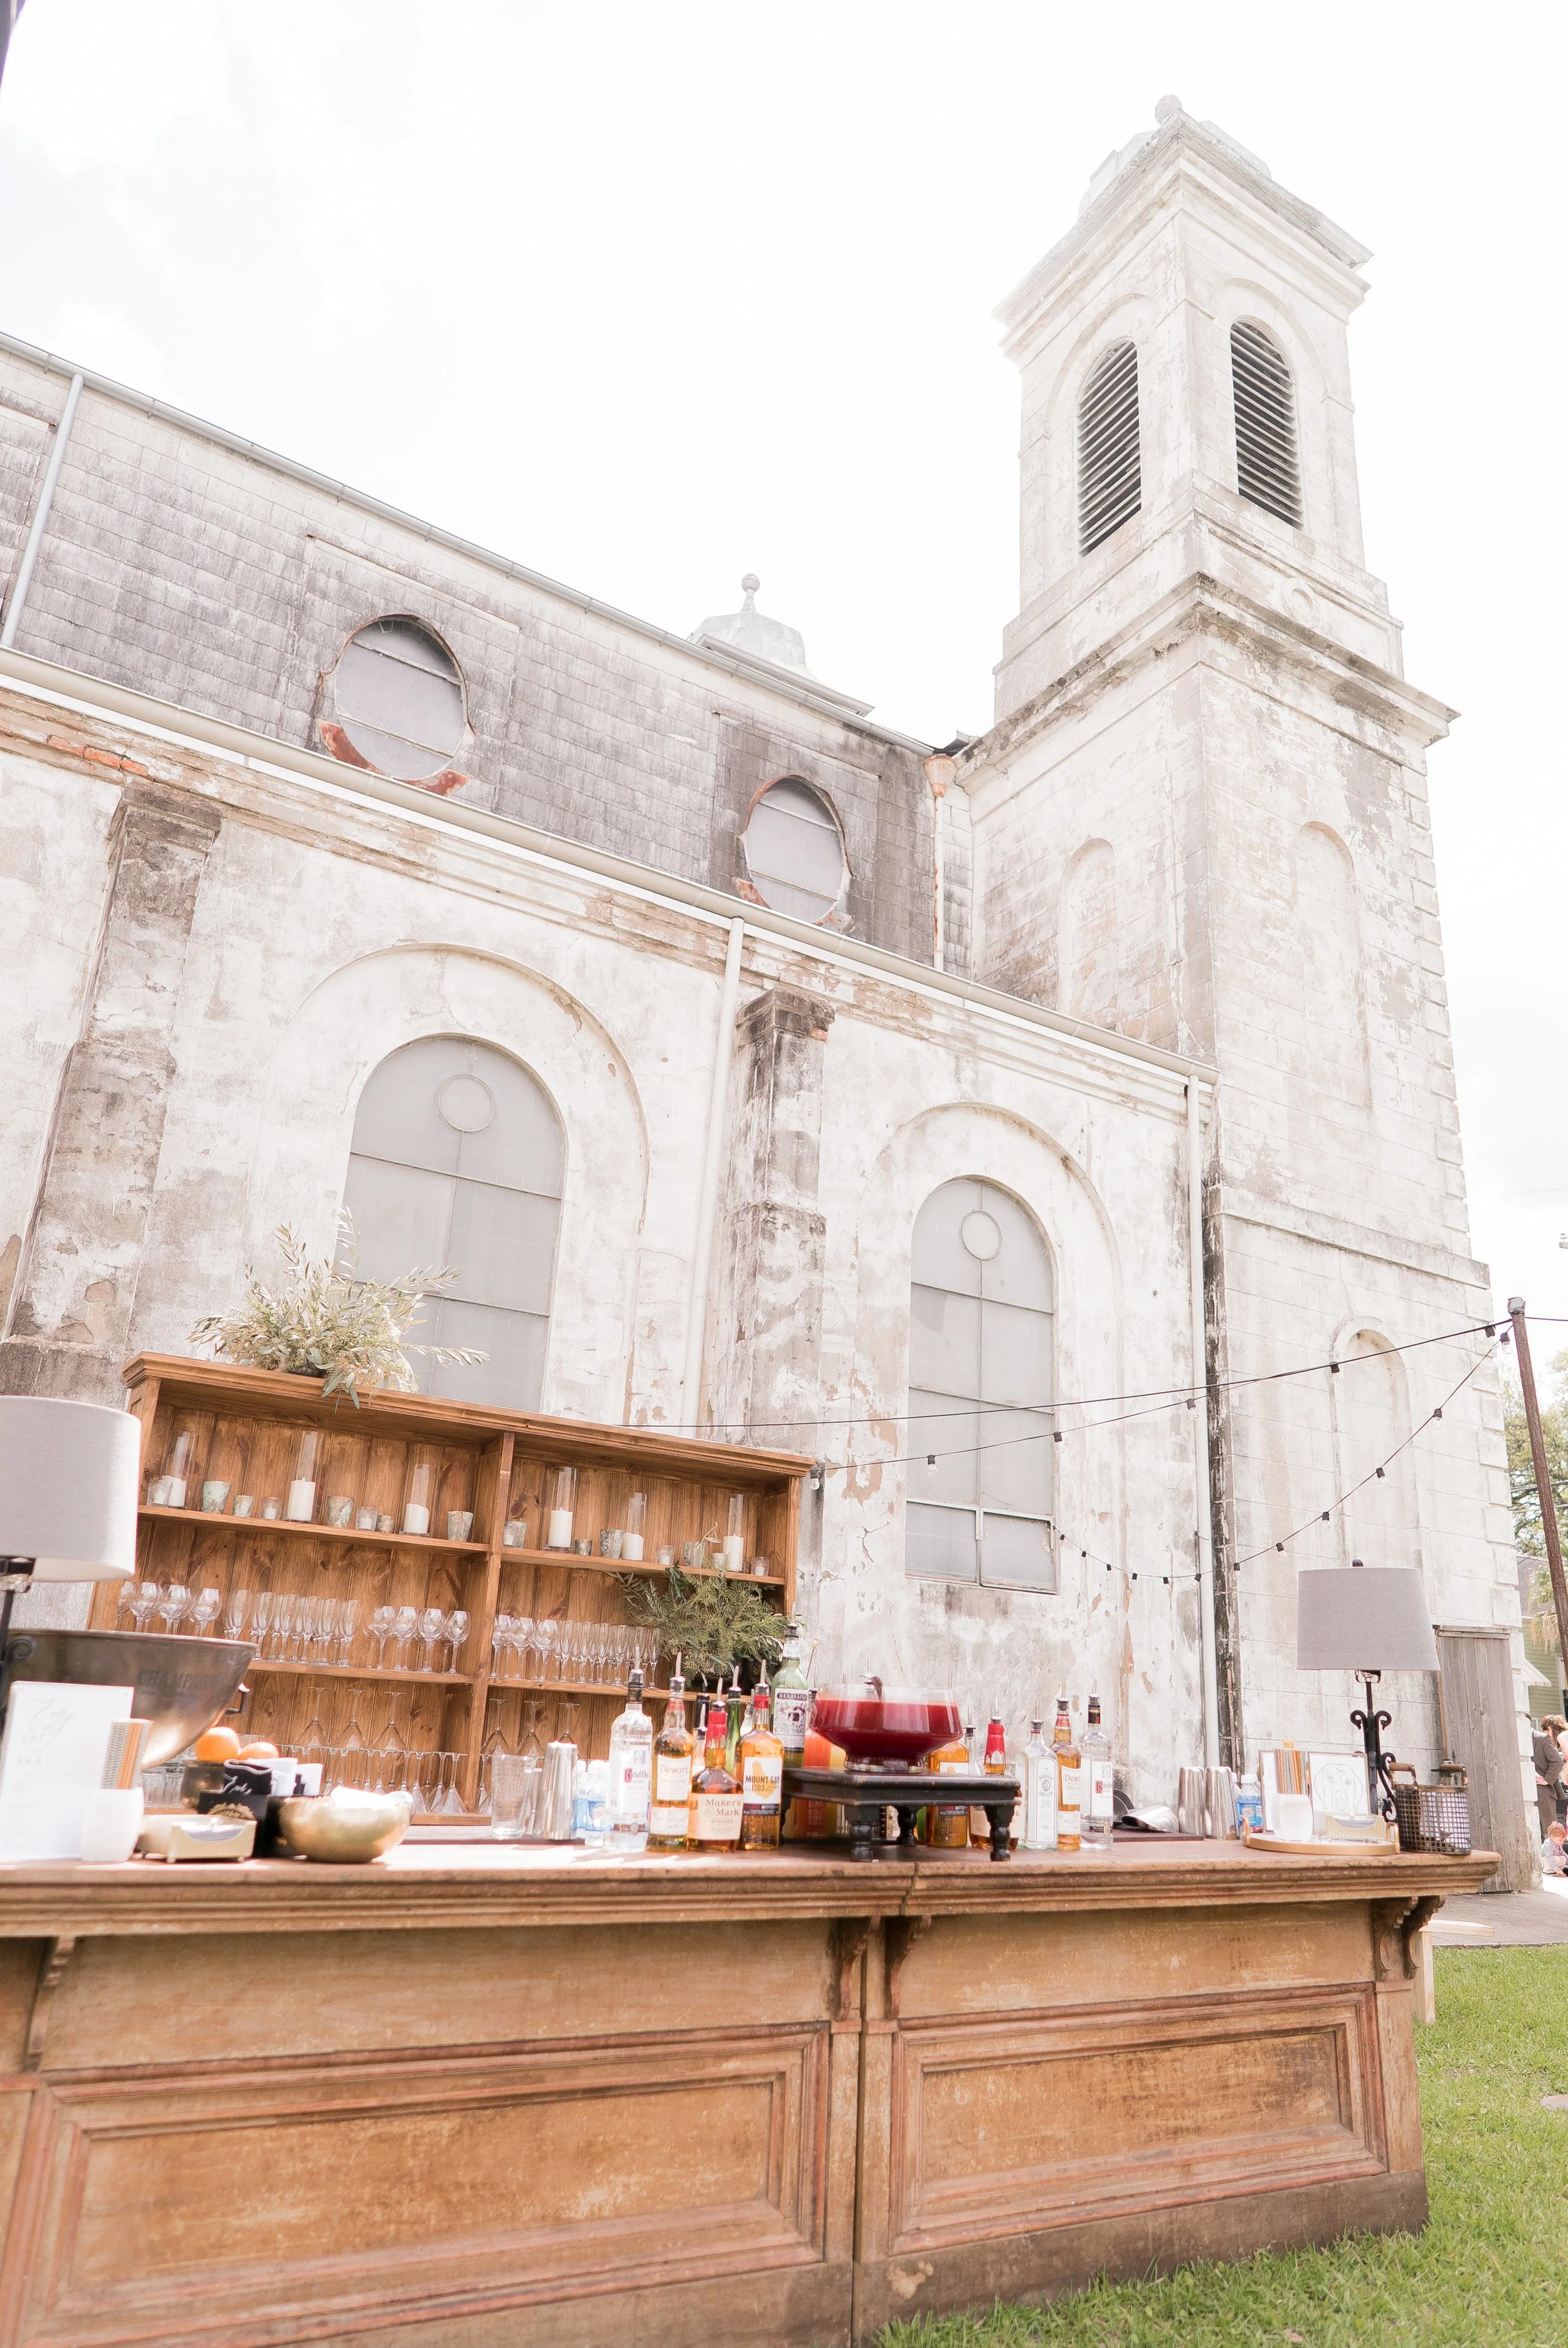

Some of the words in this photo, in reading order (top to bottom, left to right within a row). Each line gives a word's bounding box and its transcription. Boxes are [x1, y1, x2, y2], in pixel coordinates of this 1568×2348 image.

[745, 1775, 769, 1784] MOUNT
[770, 1775, 780, 1784] GAY
[751, 1784, 765, 1792] 1703
